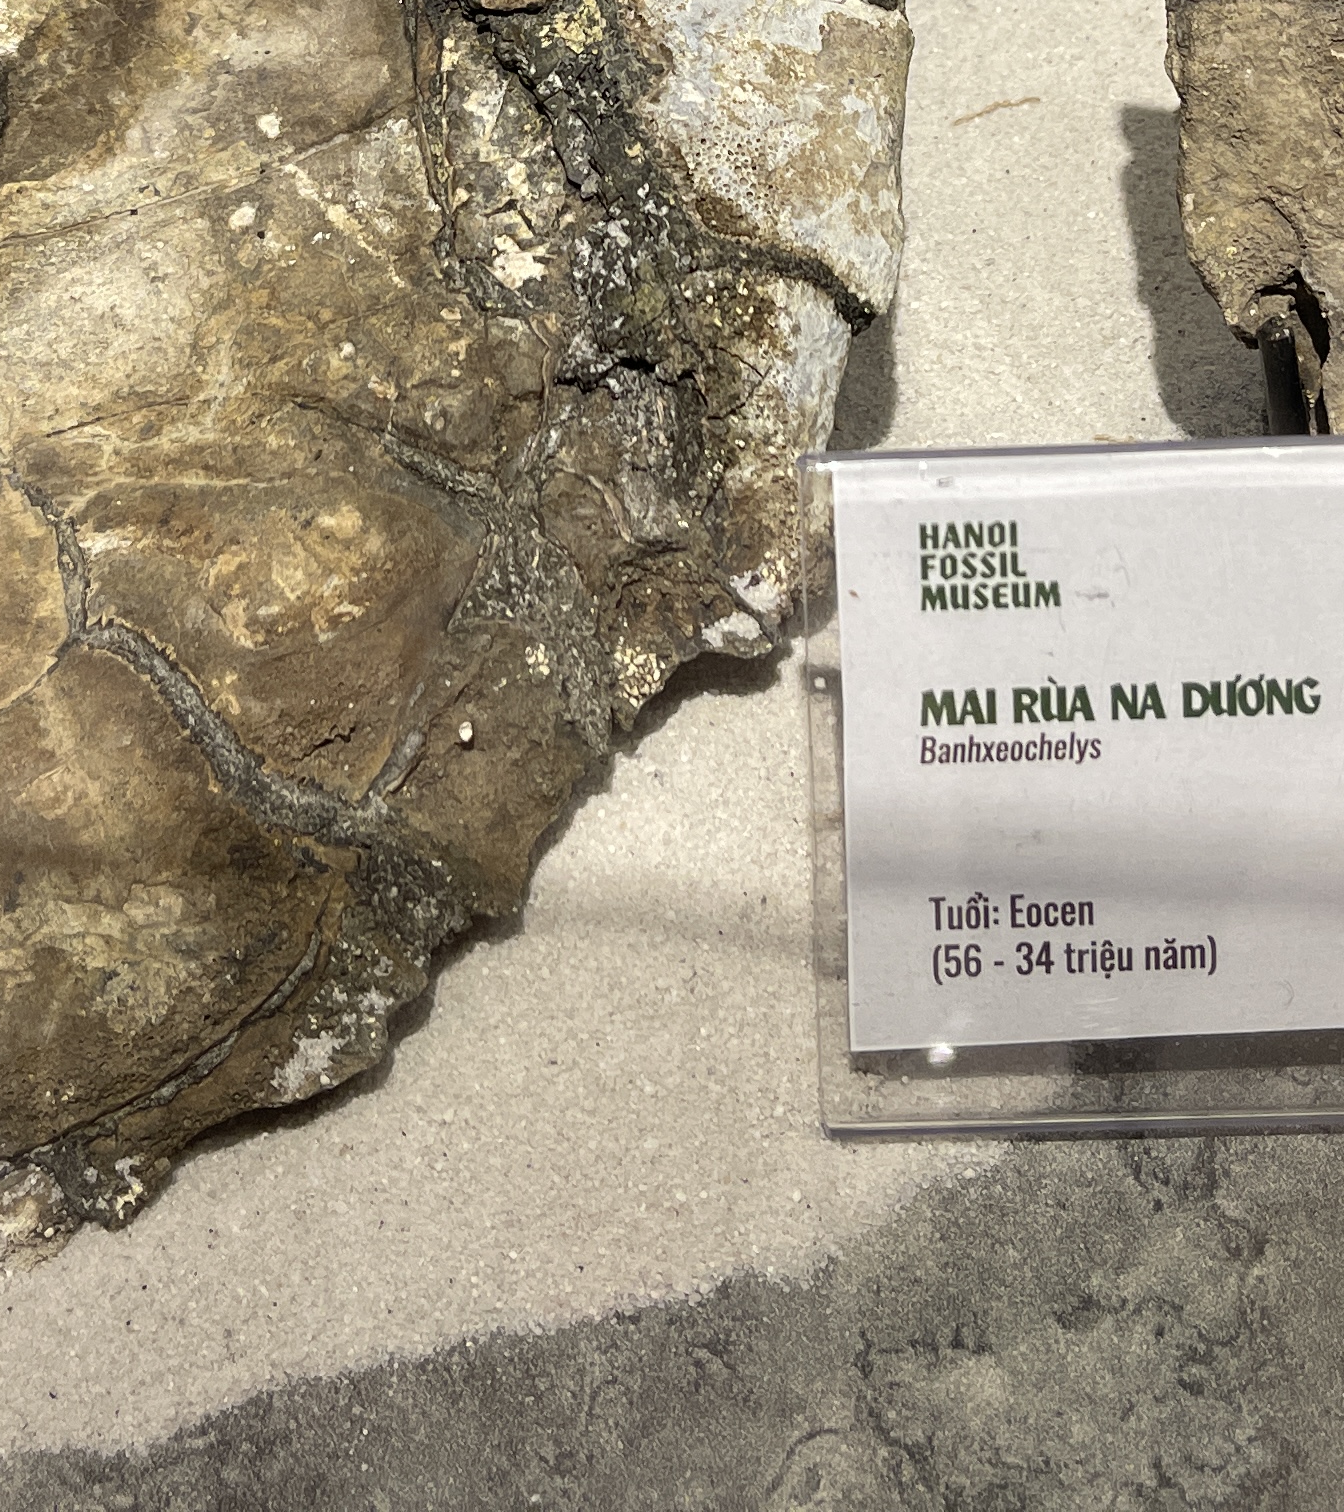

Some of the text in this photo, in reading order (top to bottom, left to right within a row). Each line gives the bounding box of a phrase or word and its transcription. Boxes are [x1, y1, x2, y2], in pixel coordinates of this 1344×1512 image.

[918, 519, 1019, 551] HANOI
[919, 550, 1028, 582] FOSSIL
[920, 579, 1062, 613] MUSEUM
[920, 673, 1323, 728] MAI RÙA NA DƯƠNG
[919, 731, 1102, 767] Banhxeochelys
[928, 891, 1095, 932] Tuổi: Eocen
[932, 934, 1218, 986] (56 - 34 triệu năm)
